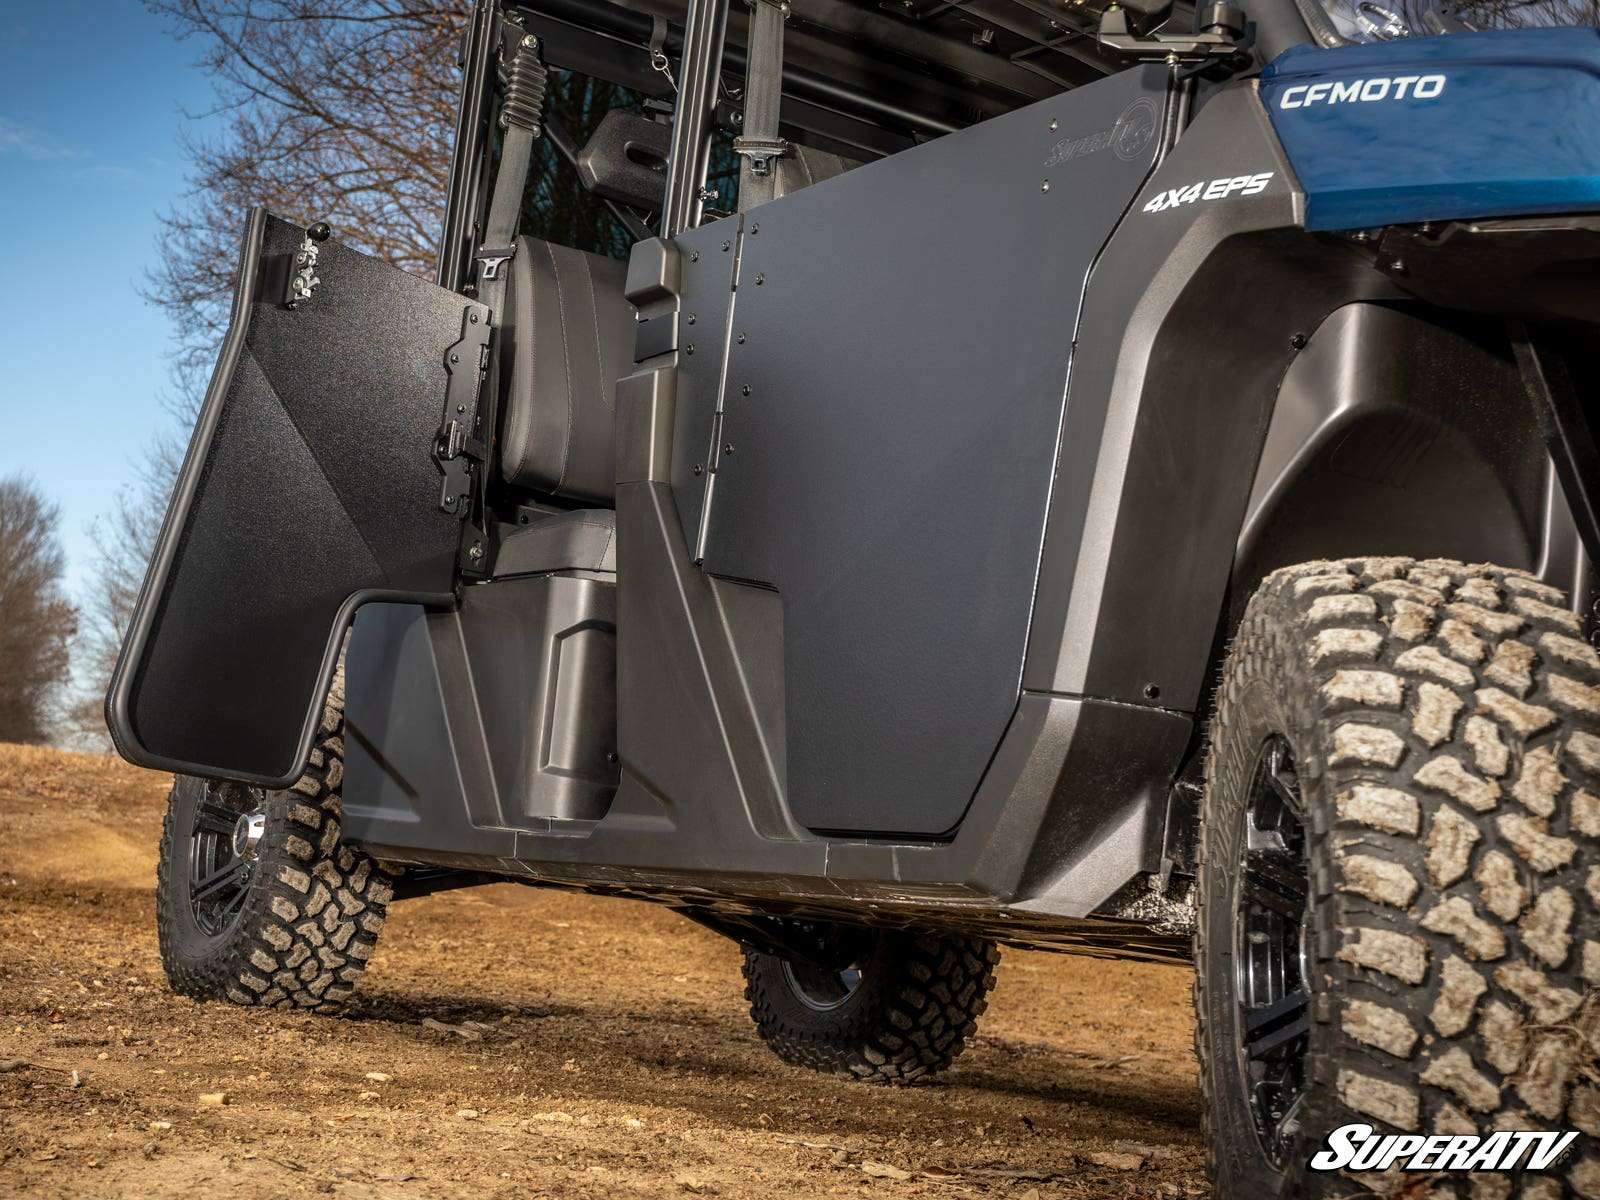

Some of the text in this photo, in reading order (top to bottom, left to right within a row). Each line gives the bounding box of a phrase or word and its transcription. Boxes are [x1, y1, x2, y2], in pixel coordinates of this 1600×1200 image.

[1280, 75, 1446, 109] CFMOTO
[1143, 172, 1274, 213] 4X4 EPS
